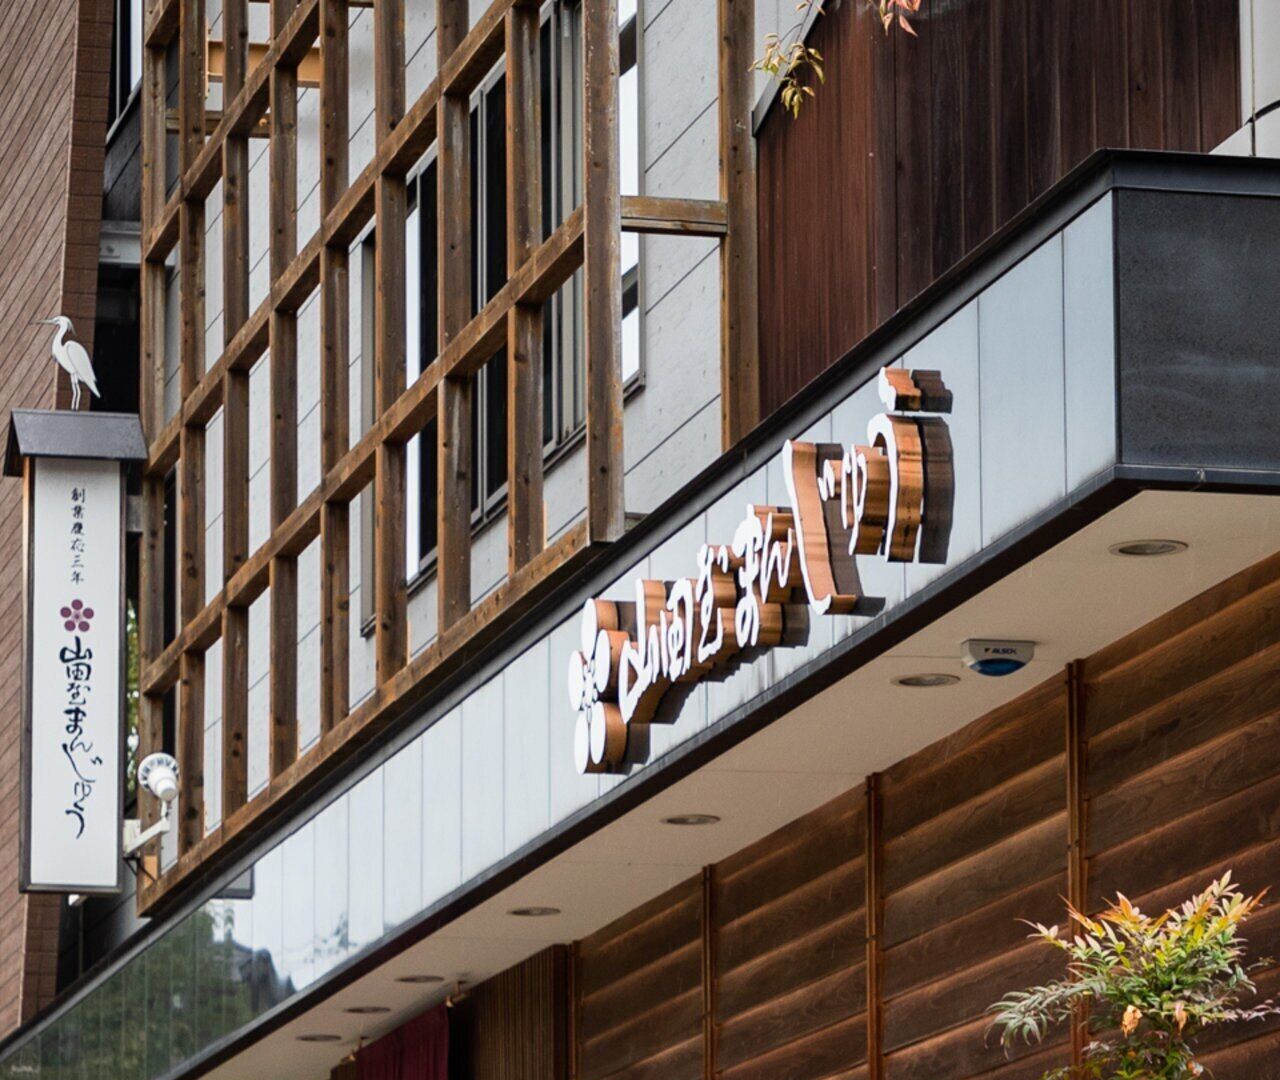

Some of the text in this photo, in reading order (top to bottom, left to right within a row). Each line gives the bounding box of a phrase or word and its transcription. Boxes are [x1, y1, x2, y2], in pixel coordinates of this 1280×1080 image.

[71, 487, 86, 585] 創業慶応三年
[992, 647, 1017, 655] ALSOK
